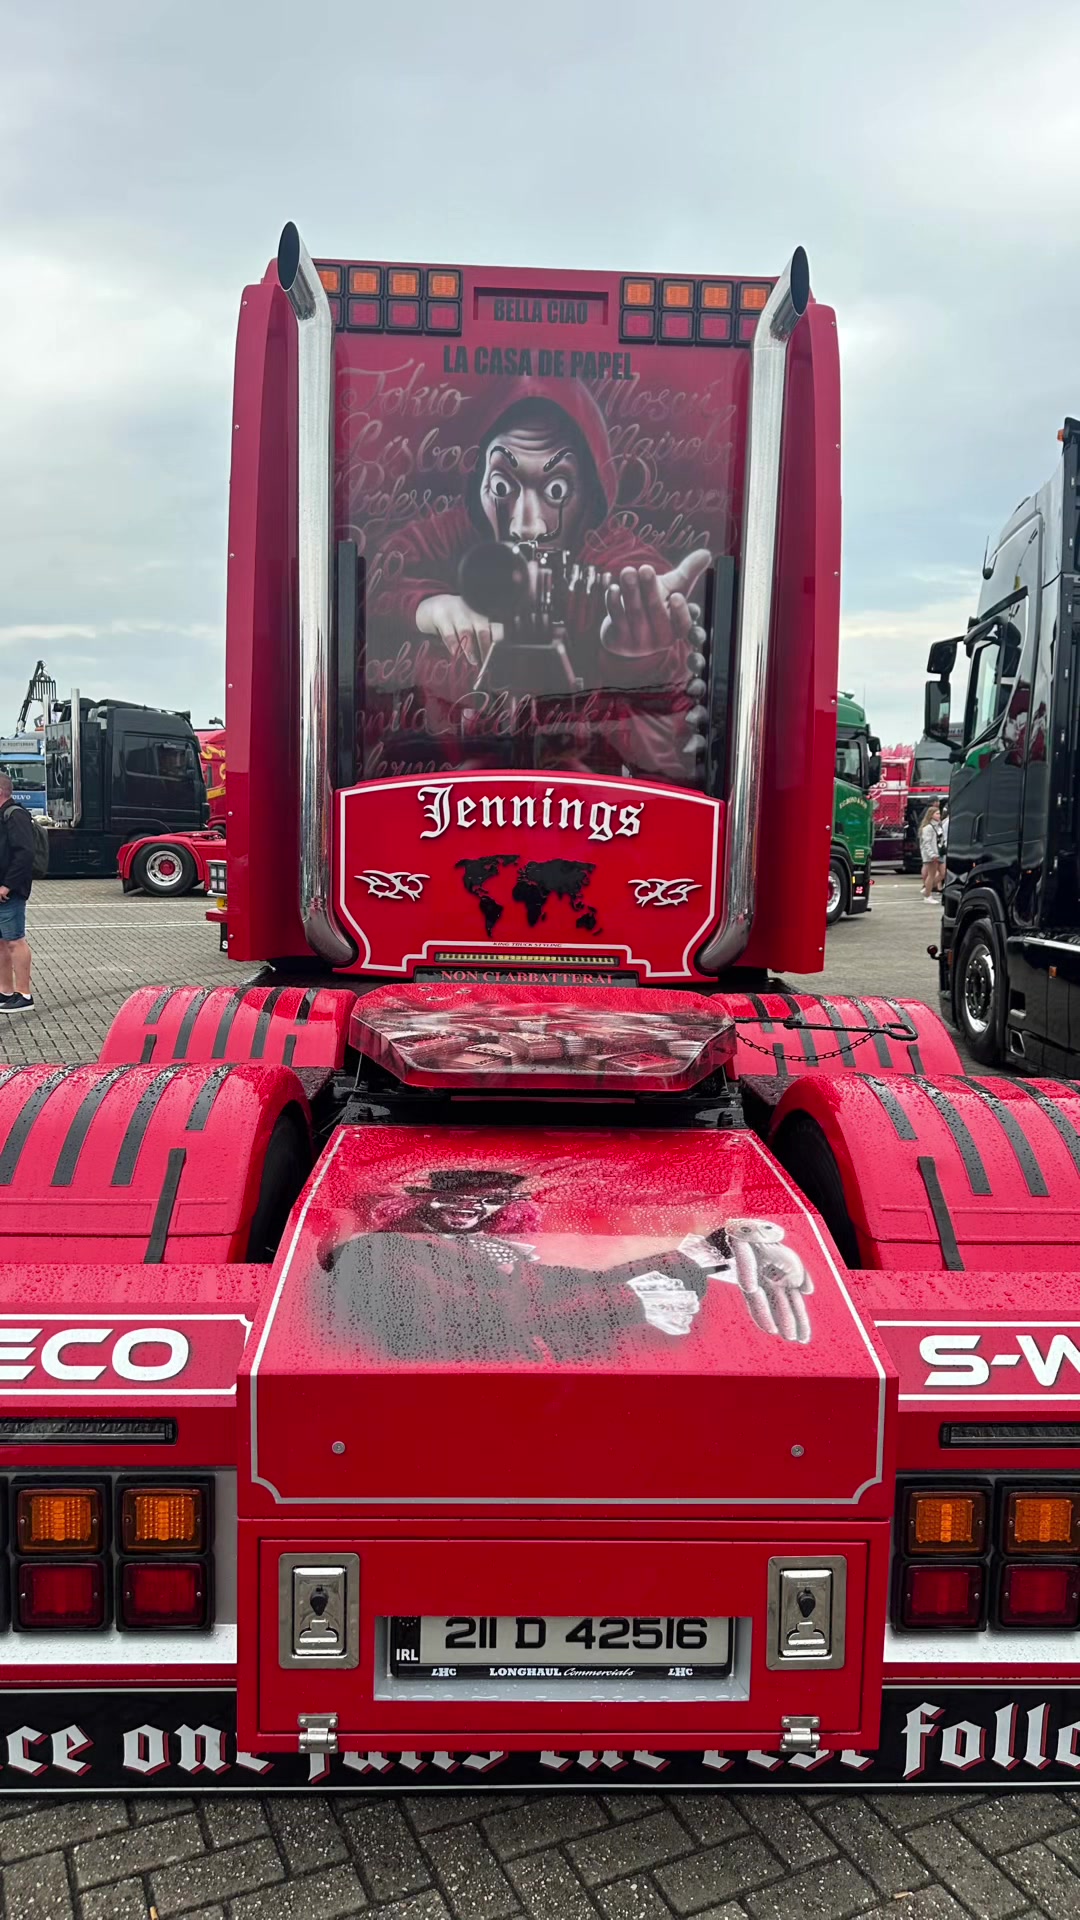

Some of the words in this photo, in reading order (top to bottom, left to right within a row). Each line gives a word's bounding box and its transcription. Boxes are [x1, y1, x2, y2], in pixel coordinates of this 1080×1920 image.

[494, 298, 544, 322] BELLA
[547, 300, 588, 324] CIAO
[443, 345, 468, 373] LA
[474, 347, 532, 376] CASA
[539, 350, 564, 377] DE
[570, 351, 634, 380] PAPEL
[338, 358, 472, 417] Tokio
[417, 784, 645, 842] Jennings
[440, 970, 480, 982] NON
[482, 971, 501, 982] CI
[505, 972, 613, 984] ABBATTERAI
[445, 1617, 497, 1649] 211
[515, 1617, 546, 1649] D
[565, 1617, 708, 1649] 42516
[395, 1649, 419, 1661] IRL
[431, 1667, 458, 1677] LHC
[489, 1667, 562, 1677] LONGHAUL
[563, 1667, 636, 1678] Commercials
[668, 1667, 694, 1677] LHC
